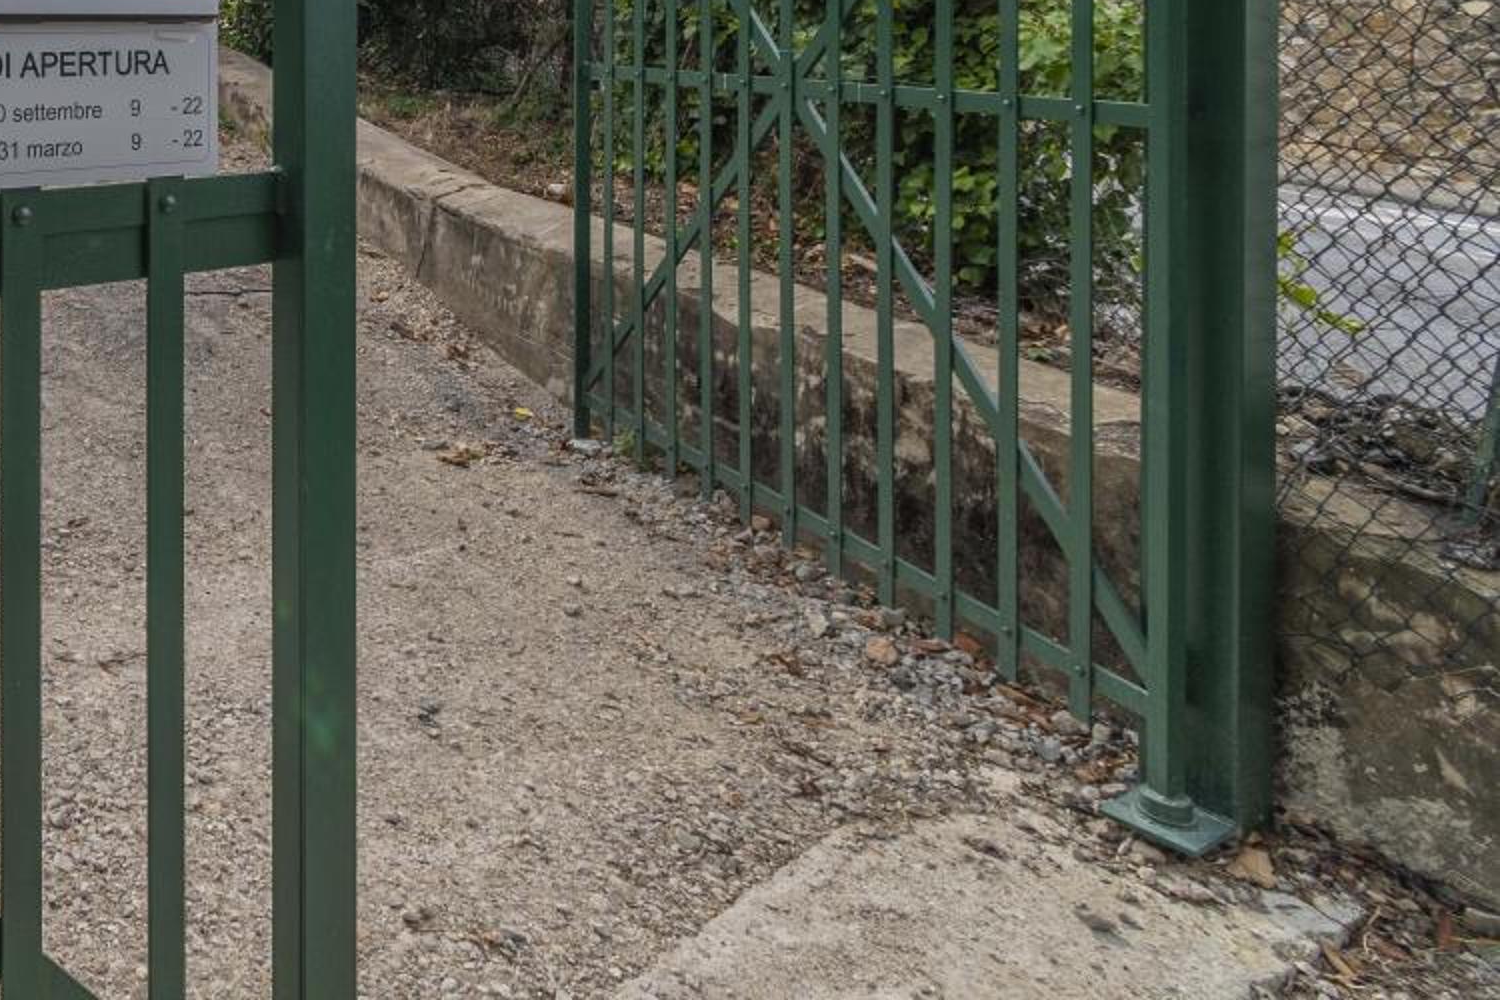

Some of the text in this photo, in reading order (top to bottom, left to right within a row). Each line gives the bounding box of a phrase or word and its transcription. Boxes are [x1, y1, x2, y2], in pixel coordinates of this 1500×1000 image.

[20, 49, 170, 78] APERTURA
[12, 100, 102, 122] settembre
[130, 98, 141, 117] 9
[26, 141, 83, 159] marzo
[131, 133, 142, 151] 9
